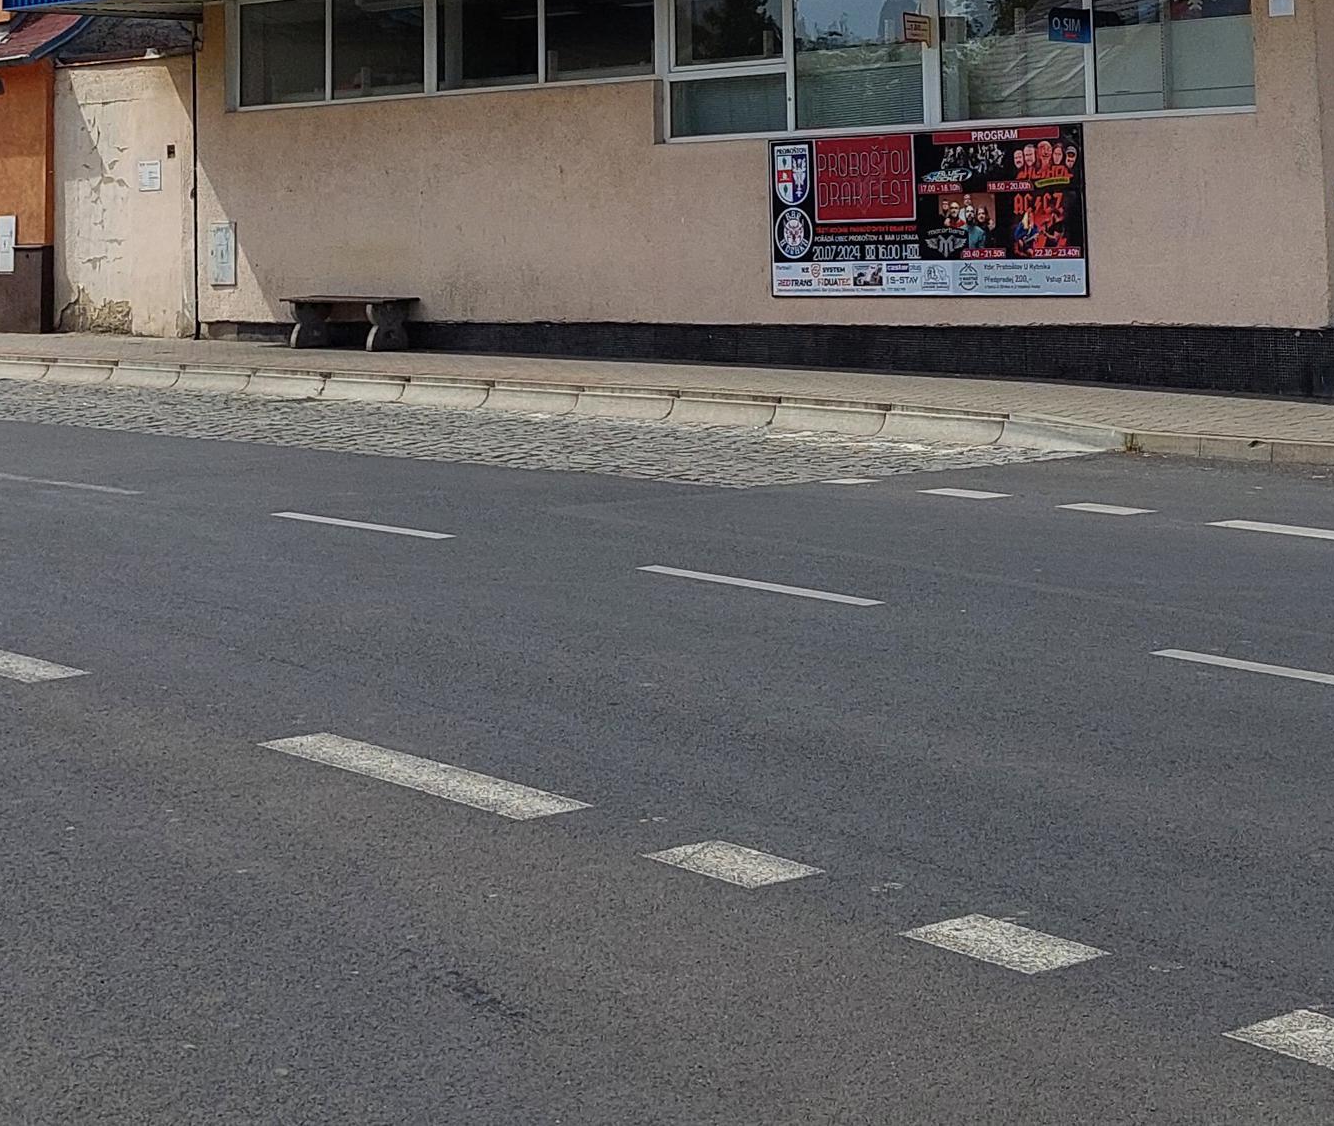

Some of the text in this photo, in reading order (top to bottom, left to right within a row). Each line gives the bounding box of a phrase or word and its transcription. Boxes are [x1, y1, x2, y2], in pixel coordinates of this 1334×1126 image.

[971, 129, 1018, 141] PROGRAM
[818, 145, 910, 177] PROBOŠTOV
[818, 179, 910, 208] DRAK FEST
[812, 245, 862, 260] 20.07.2024
